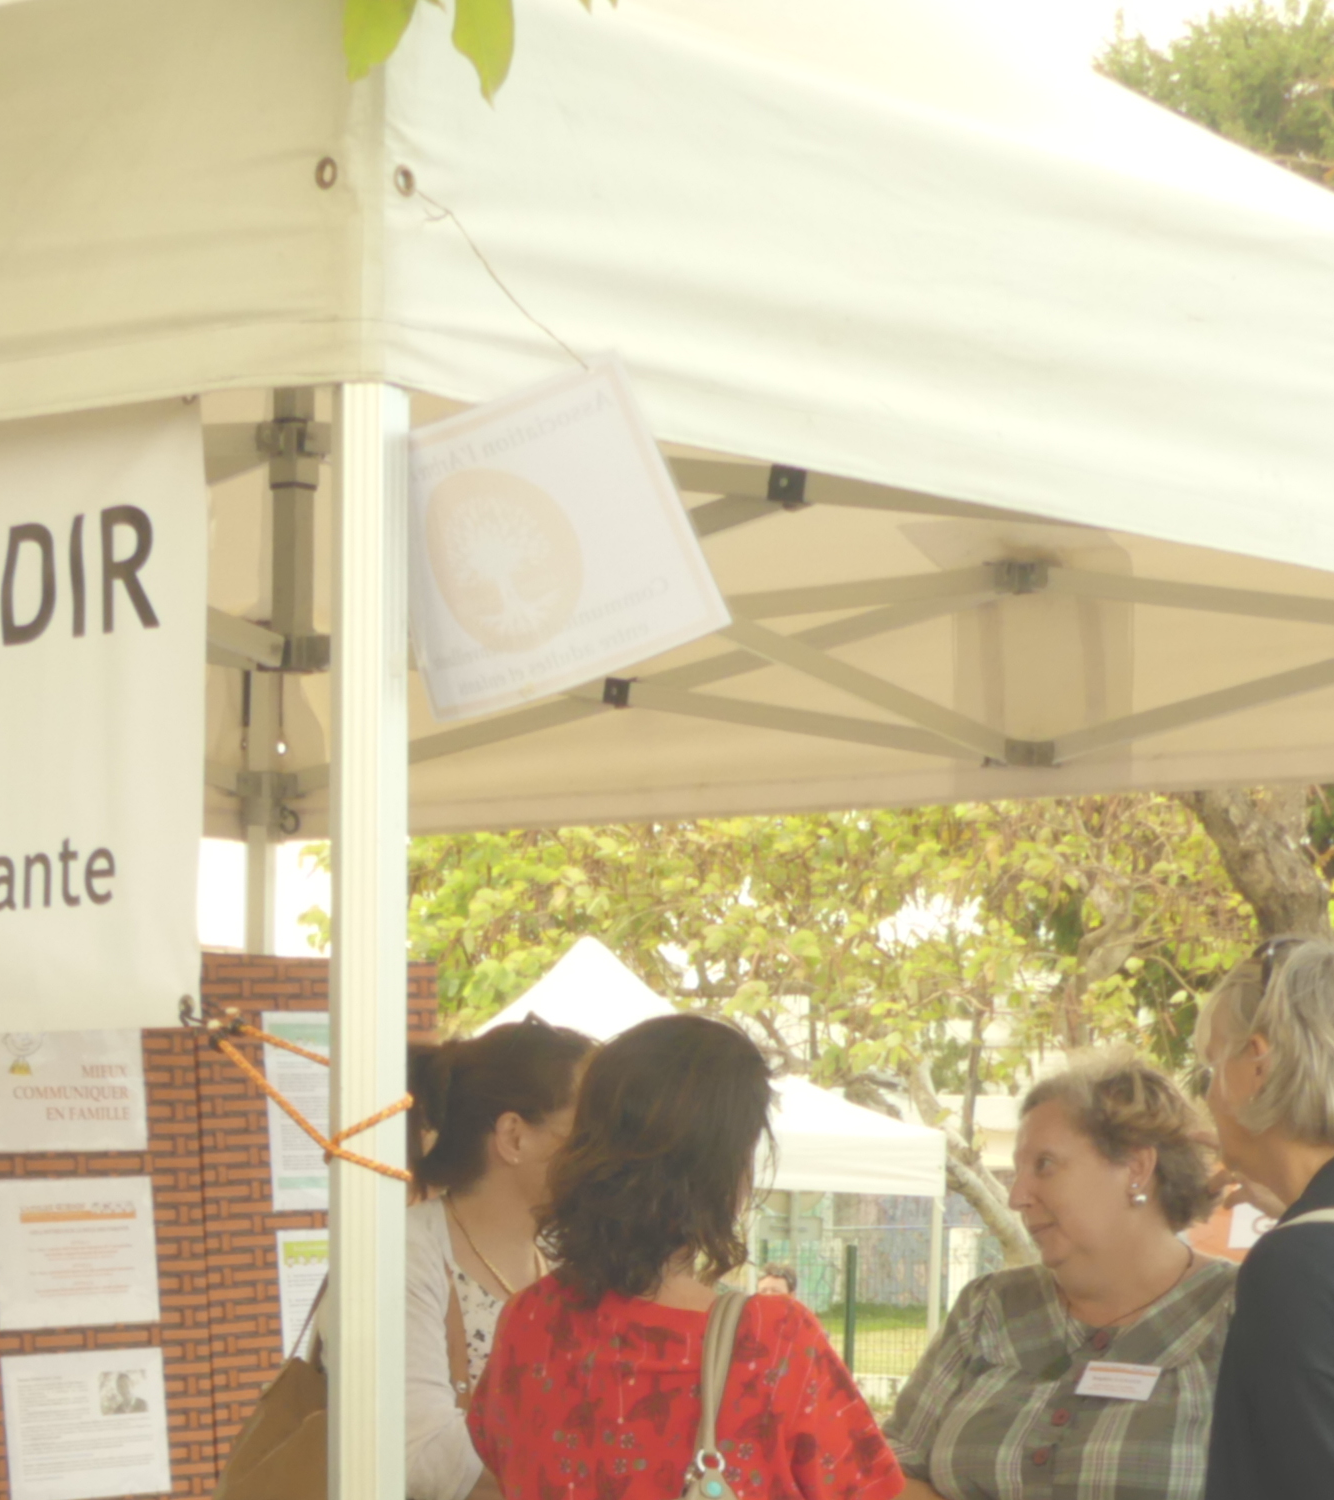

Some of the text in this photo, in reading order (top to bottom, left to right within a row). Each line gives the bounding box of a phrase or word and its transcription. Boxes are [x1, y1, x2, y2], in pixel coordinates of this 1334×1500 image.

[81, 1064, 128, 1079] MIEUX
[12, 1085, 130, 1102] COMMUNIQUER
[46, 1106, 131, 1121] EN FAMILLE
